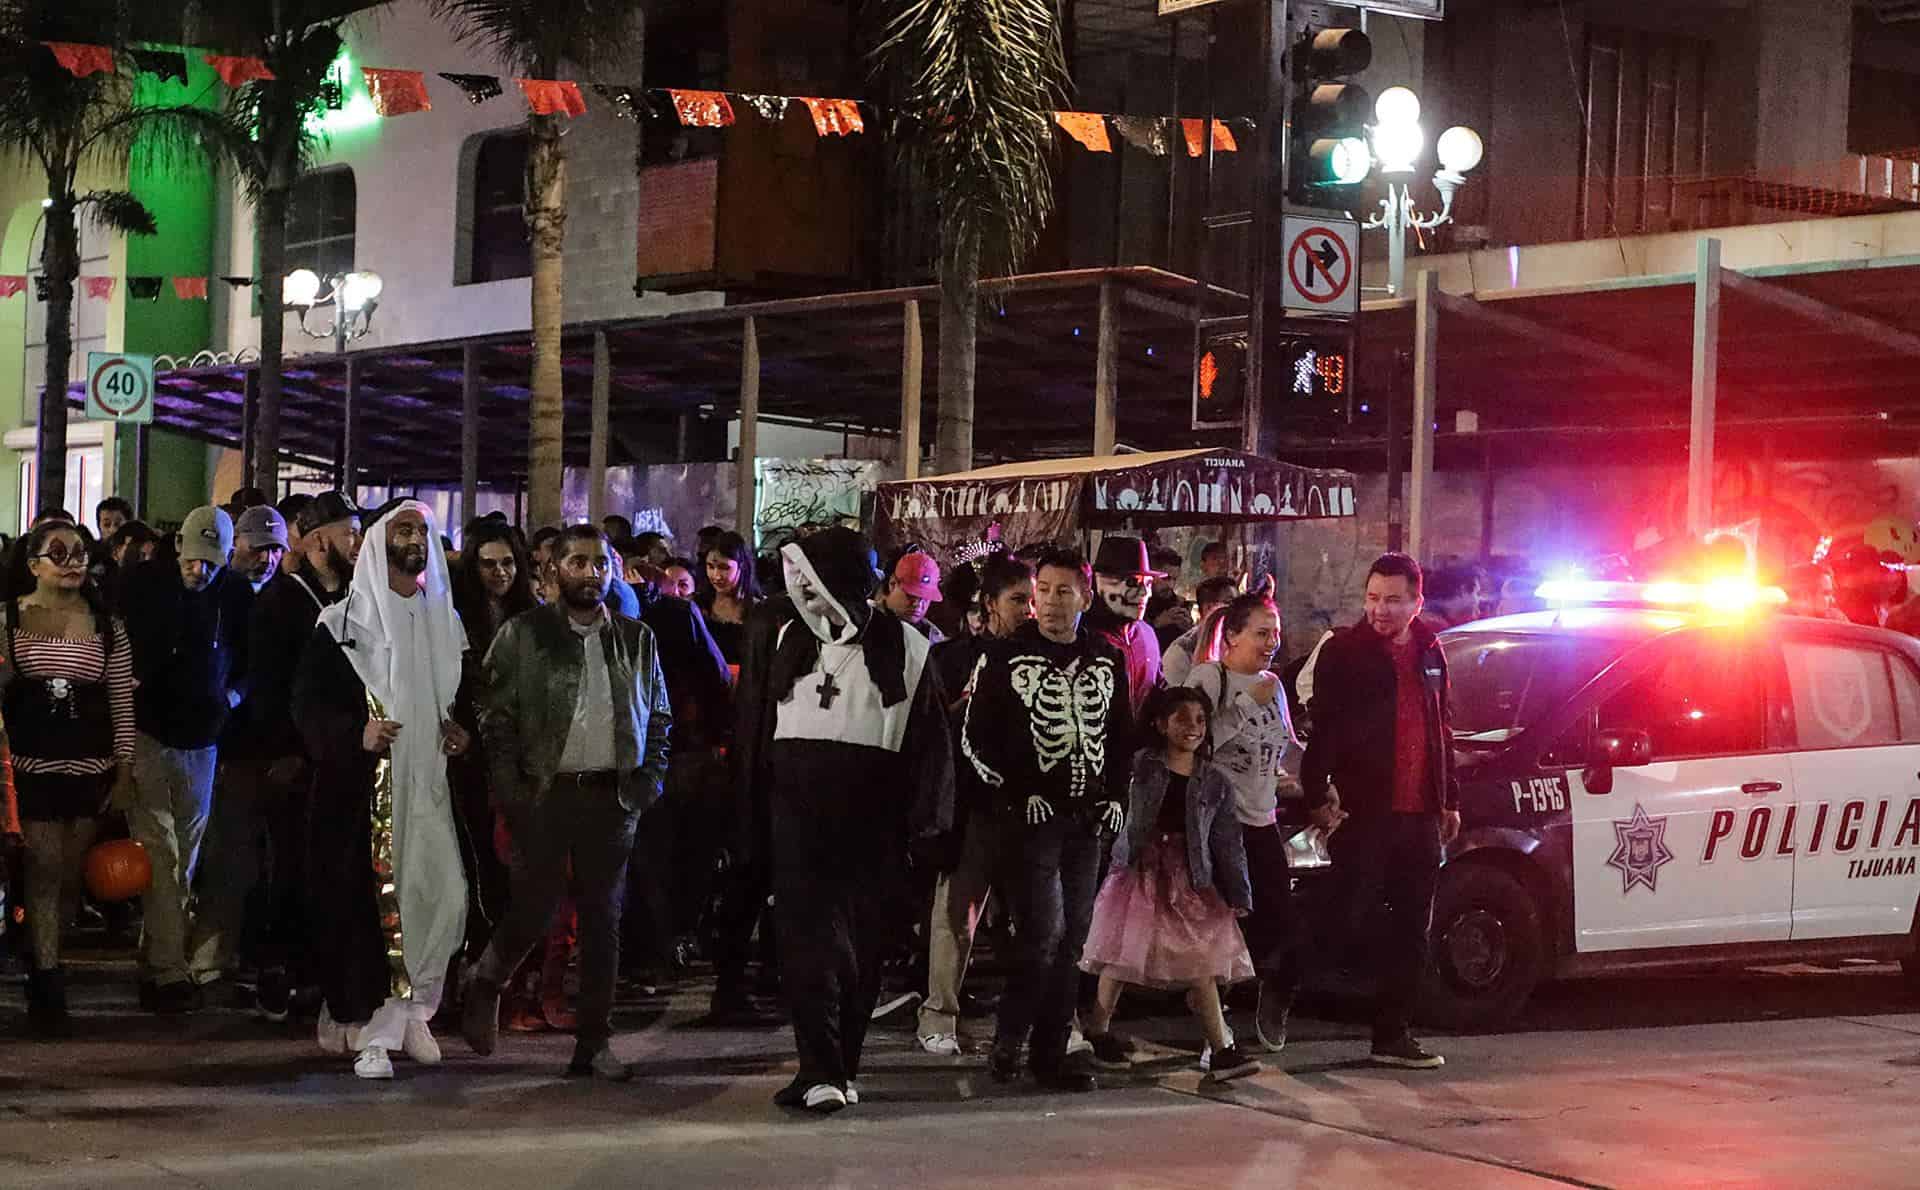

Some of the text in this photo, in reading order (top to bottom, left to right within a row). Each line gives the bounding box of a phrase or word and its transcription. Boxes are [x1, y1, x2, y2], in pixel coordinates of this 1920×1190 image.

[106, 371, 134, 395] 40
[1204, 457, 1246, 468] TIJUANA
[1511, 777, 1565, 813] P-1345
[1702, 799, 1920, 862] POLICIA
[1848, 856, 1916, 878] TIJUANA
